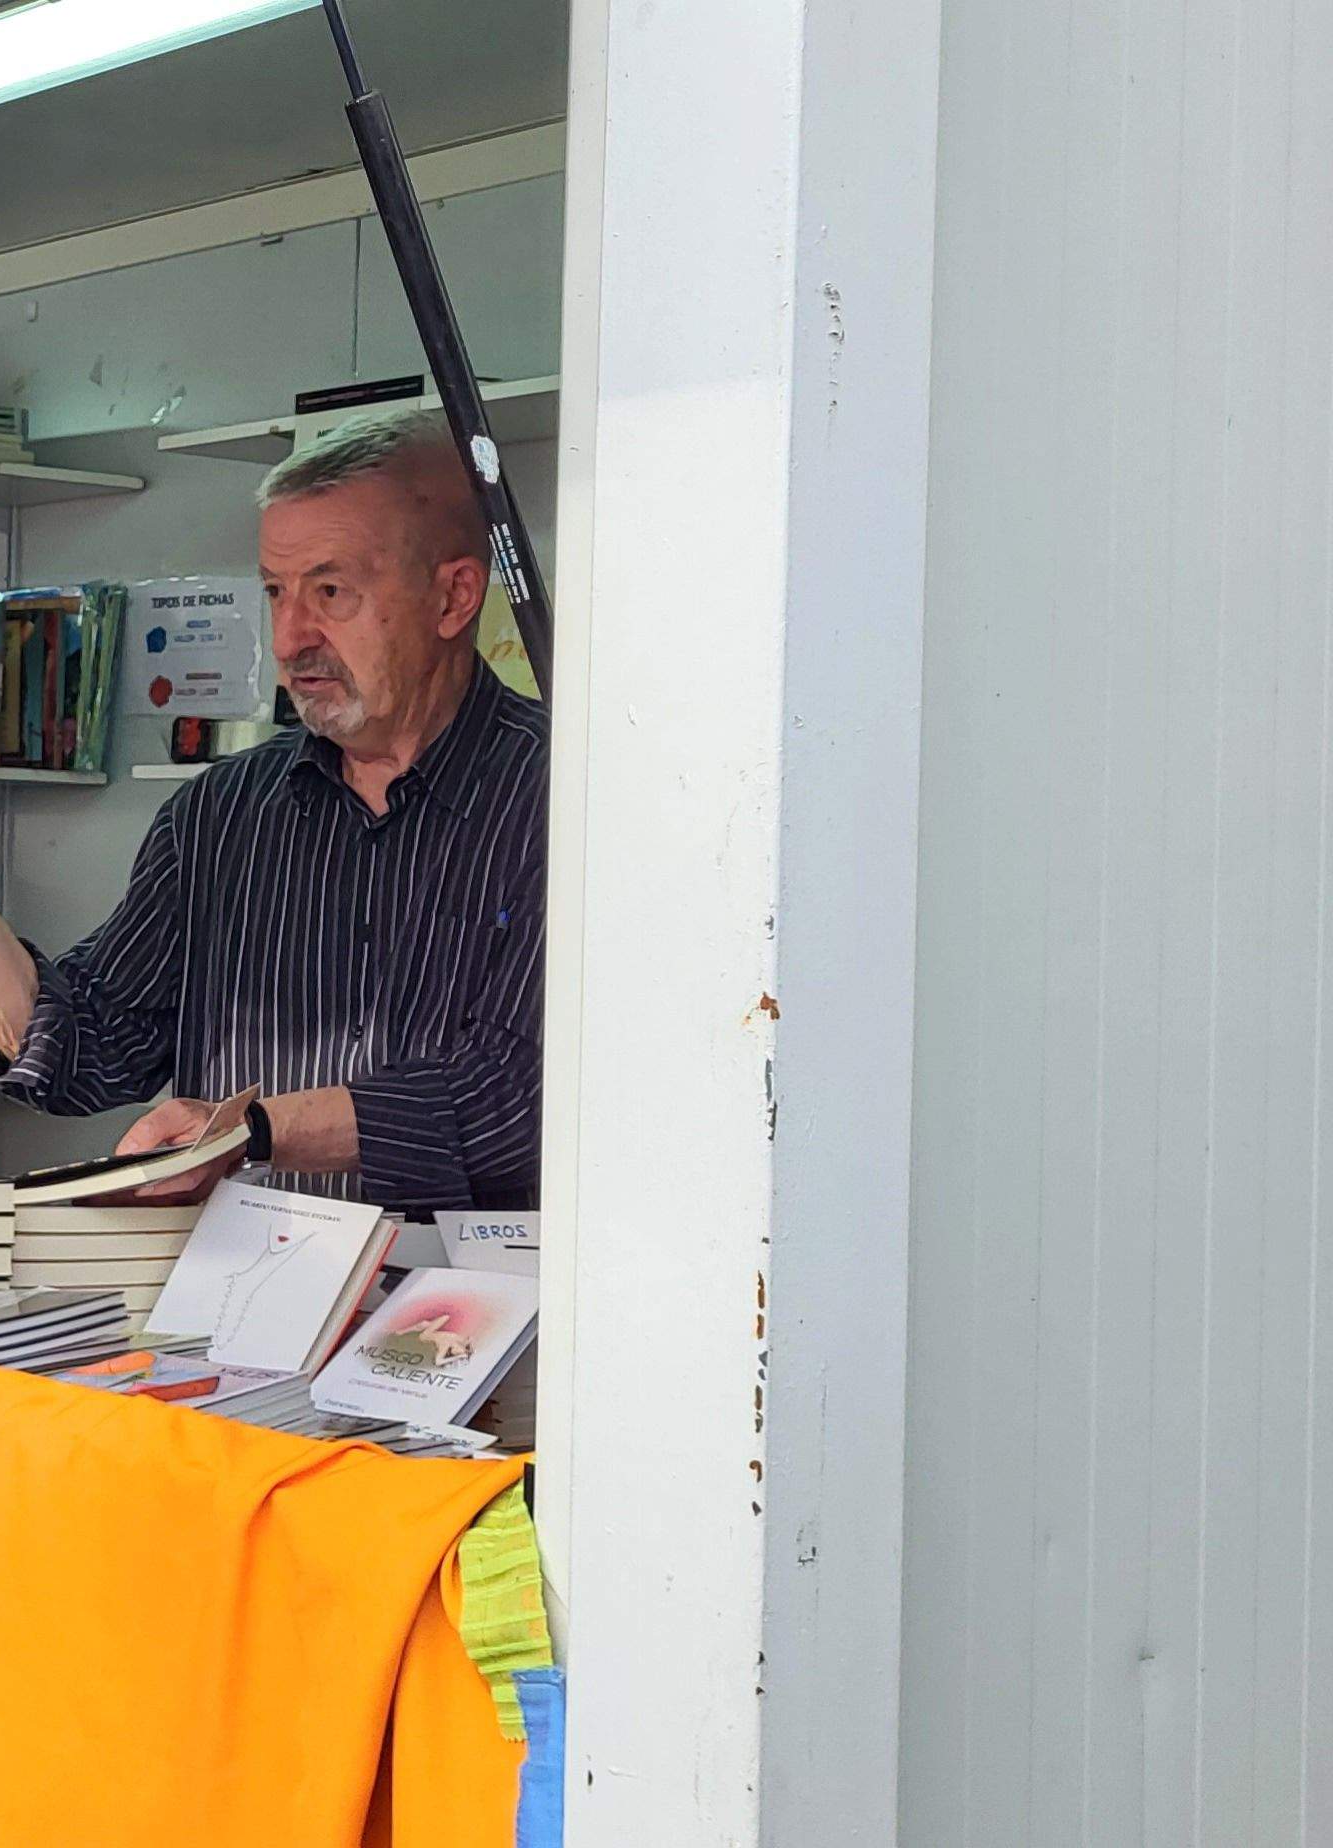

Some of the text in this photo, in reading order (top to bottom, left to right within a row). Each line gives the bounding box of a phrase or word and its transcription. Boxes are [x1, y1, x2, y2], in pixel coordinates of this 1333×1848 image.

[151, 592, 235, 609] TIPOS DE FICHAS
[459, 1223, 528, 1241] LIBROS
[353, 1345, 424, 1366] MUSGO
[371, 1363, 463, 1391] CALIENTE
